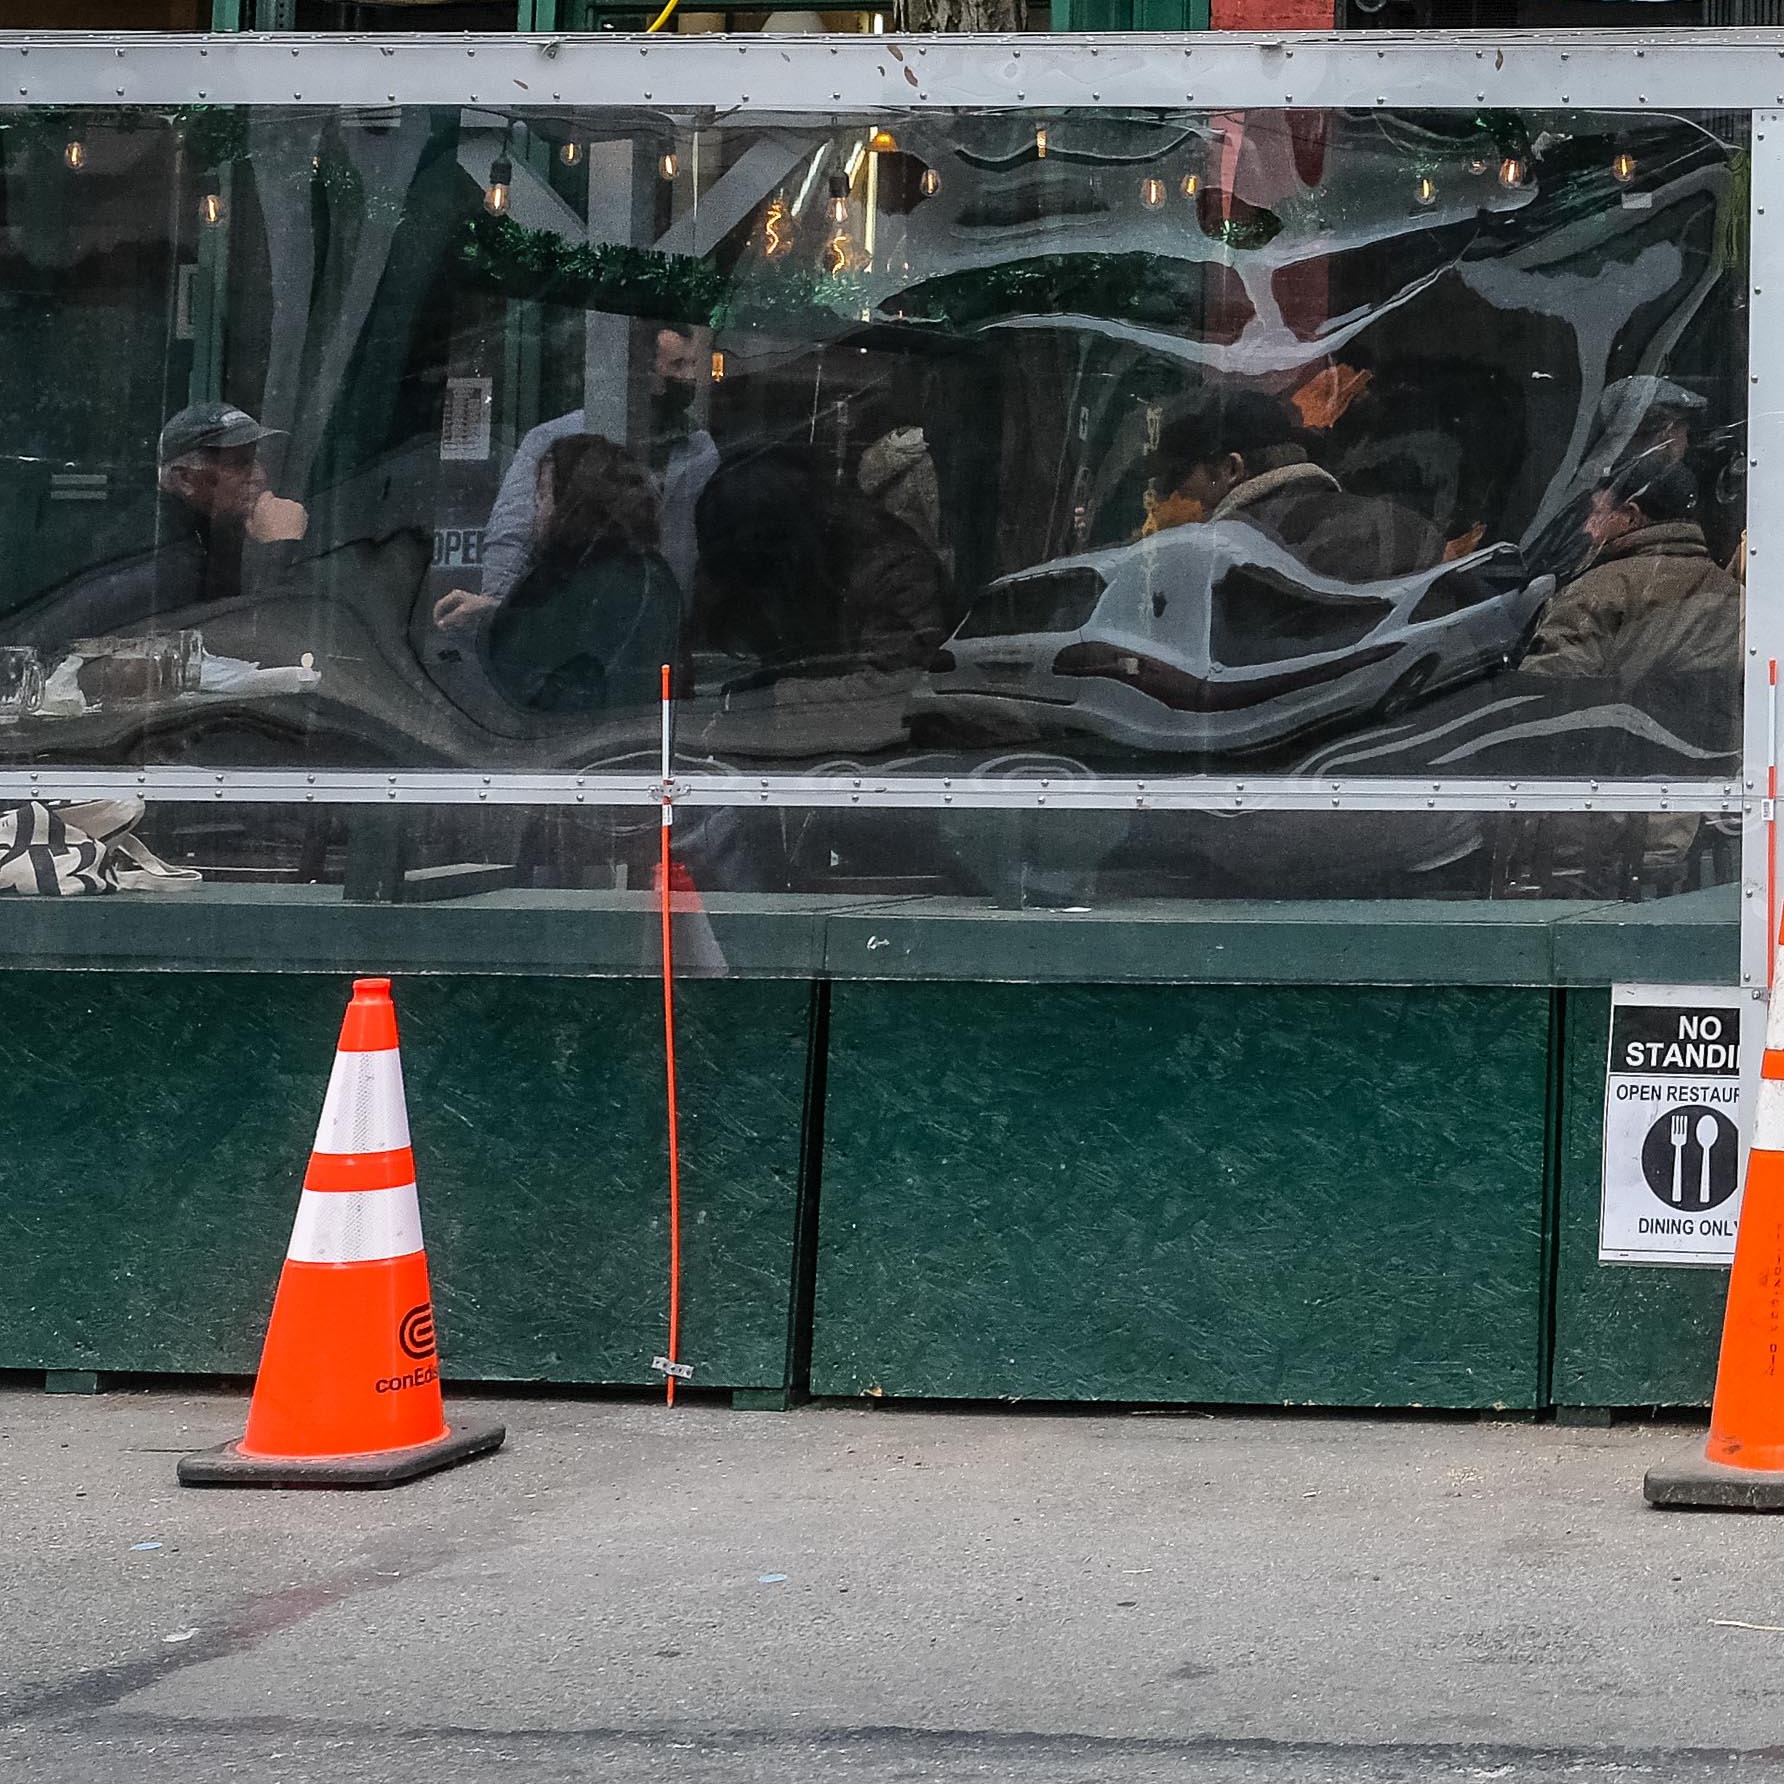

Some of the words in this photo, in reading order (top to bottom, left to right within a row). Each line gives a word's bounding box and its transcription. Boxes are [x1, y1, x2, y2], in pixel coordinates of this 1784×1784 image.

[1678, 1015, 1722, 1041] NO
[1616, 1084, 1662, 1102] OPEN
[1638, 1218, 1694, 1236] DINING
